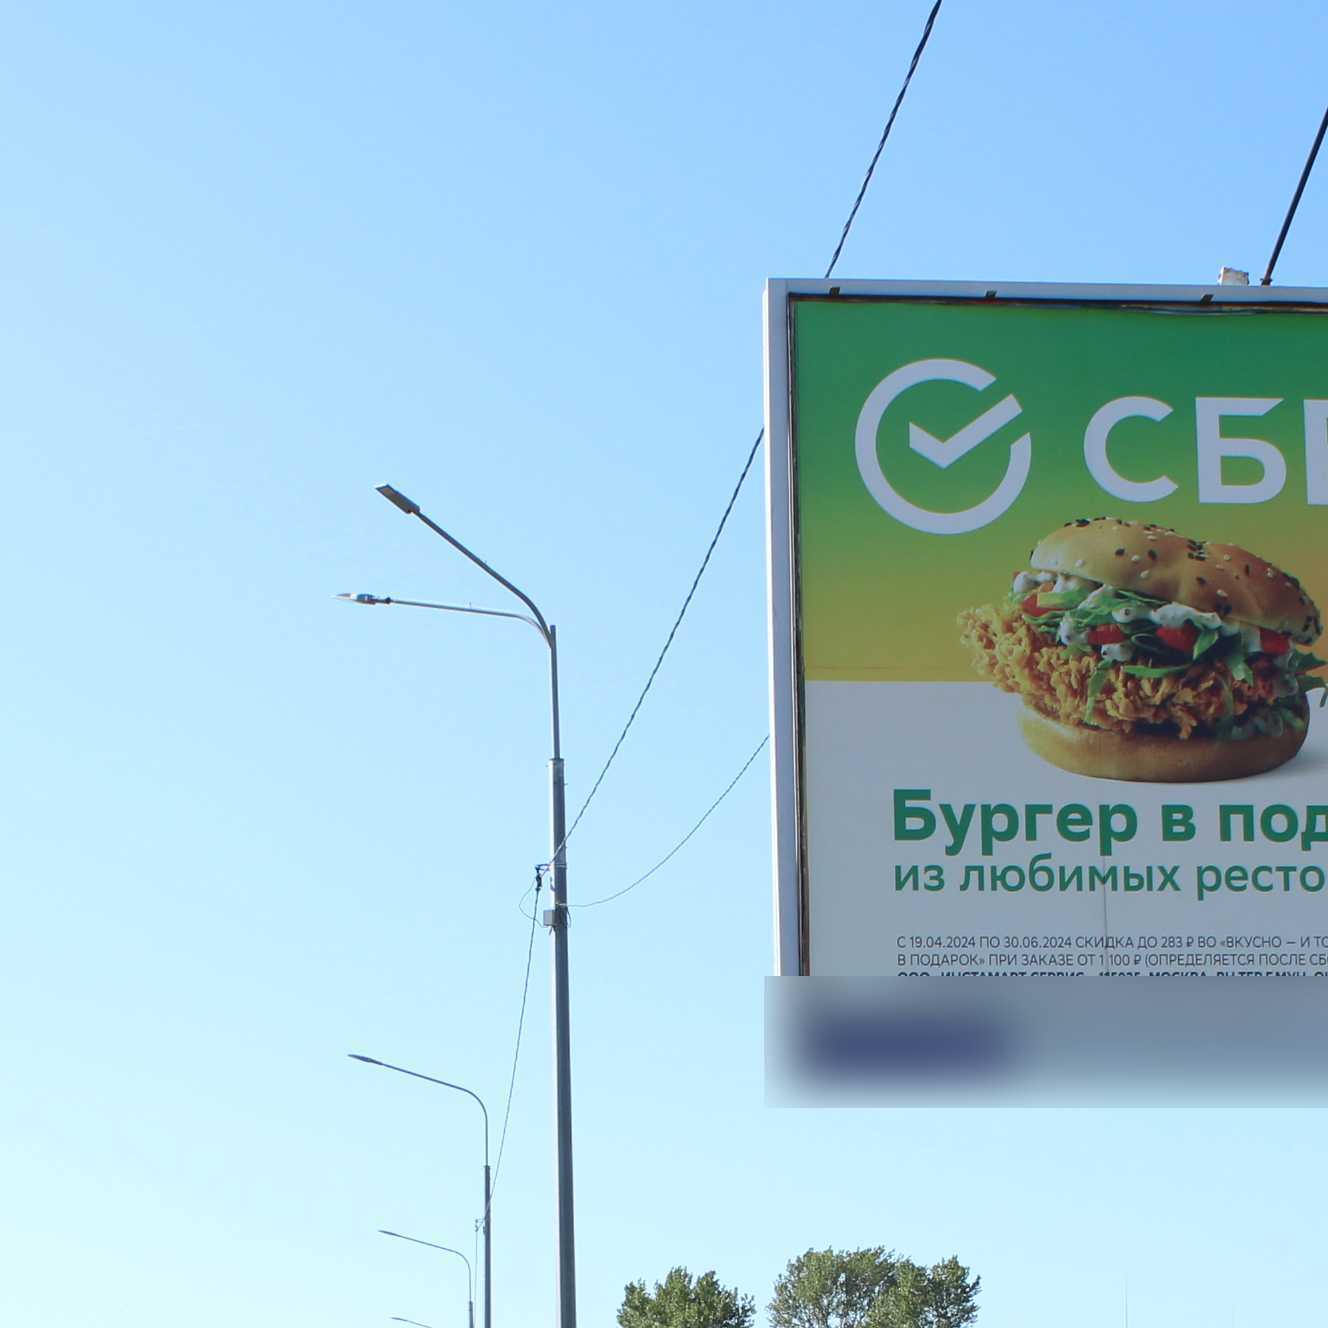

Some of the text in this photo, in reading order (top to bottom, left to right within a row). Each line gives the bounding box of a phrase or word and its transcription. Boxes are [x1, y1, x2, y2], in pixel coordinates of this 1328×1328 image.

[893, 789, 1137, 856] Бургер
[1161, 804, 1197, 841] в
[894, 864, 944, 892] из
[960, 855, 1181, 892] любимых
[896, 935, 906, 949] С
[909, 935, 976, 949] 19.04.2024
[979, 935, 1000, 949] ПО
[1004, 935, 1072, 949] 30.06.2024
[1075, 935, 1134, 951] СКИДКА
[1137, 935, 1158, 951] ДО
[1161, 935, 1183, 949] 283
[1197, 935, 1217, 949] ВО
[1219, 935, 1282, 949] «ВКУСНО
[1300, 935, 1310, 949] И
[897, 953, 906, 966] В
[910, 953, 984, 968] ПОДАРОК»
[988, 953, 1018, 966] ПРИ
[1021, 953, 1073, 966] ЗАКАЗЕ
[1077, 953, 1096, 966] ОТ
[1144, 953, 1255, 968] (ОПРЕДЕЛЯЕТСЯ
[1258, 953, 1306, 967] ПОСЛЕ
